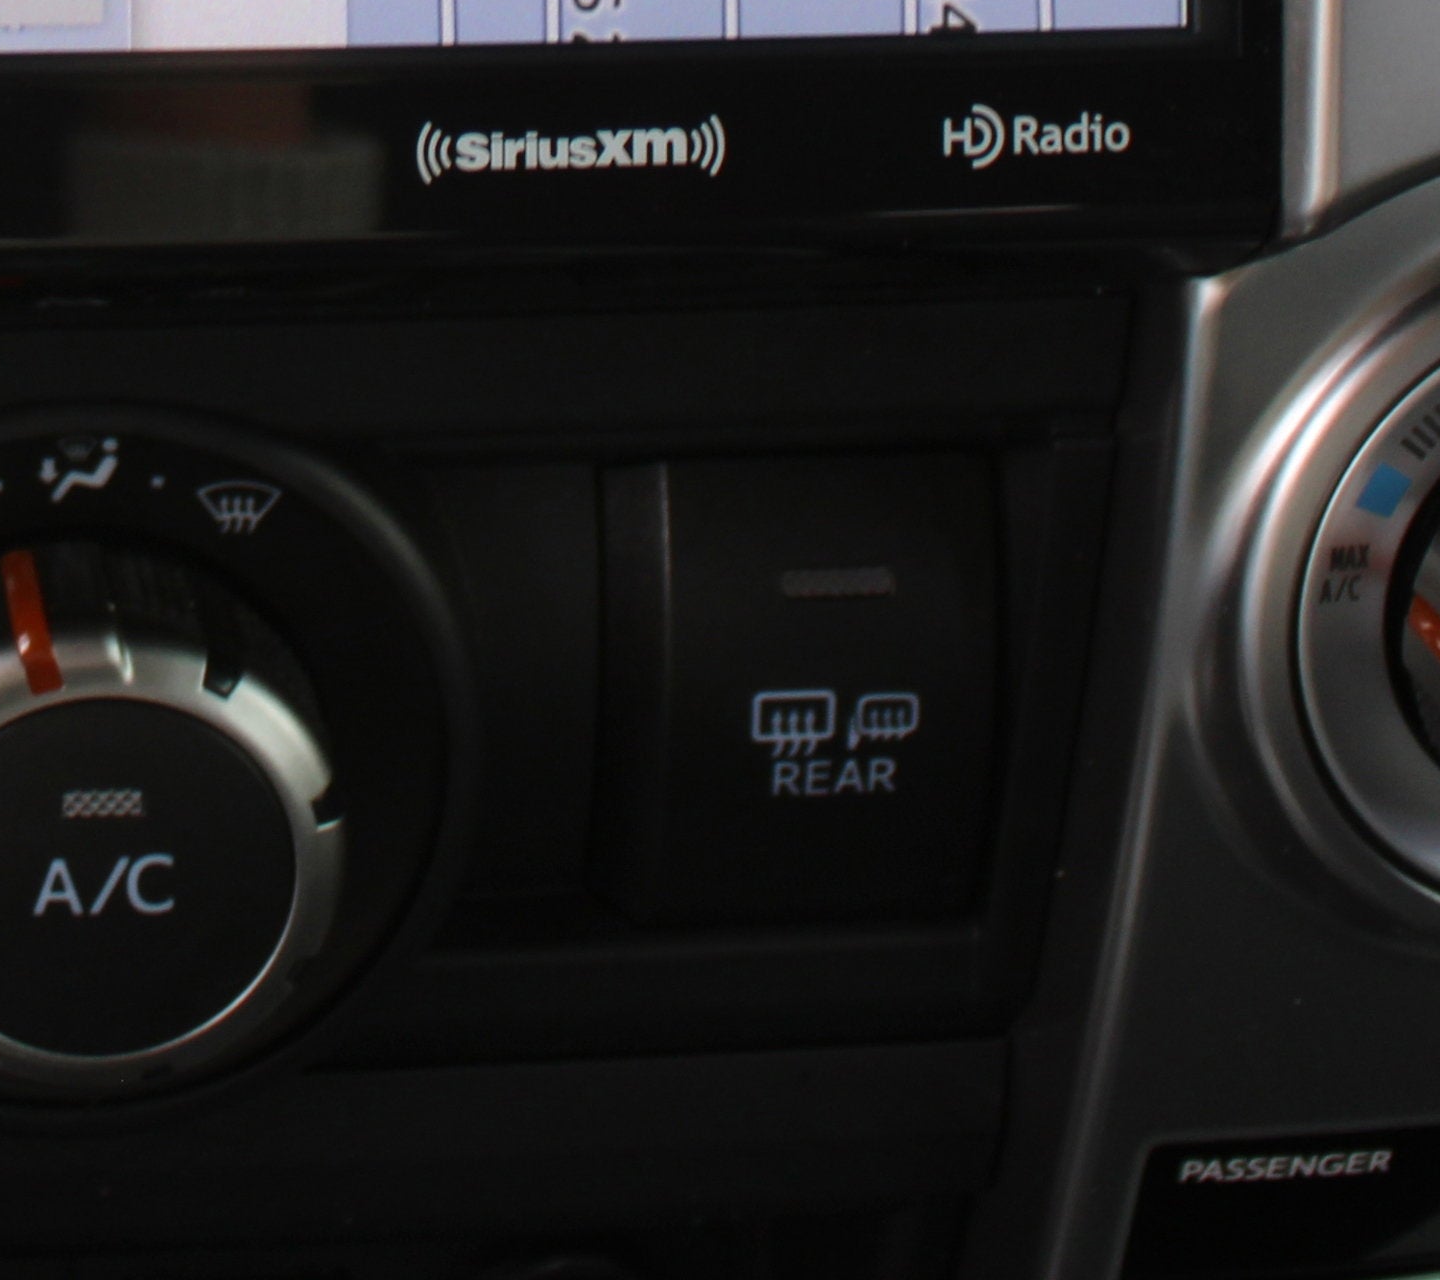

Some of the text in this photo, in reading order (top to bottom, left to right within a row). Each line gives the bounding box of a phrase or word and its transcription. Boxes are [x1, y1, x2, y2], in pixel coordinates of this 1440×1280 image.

[1014, 111, 1131, 154] Radio
[1319, 575, 1362, 605] A/C
[772, 757, 897, 797] REAR
[32, 853, 176, 918] A/C
[1179, 1149, 1393, 1183] PASSENGER
